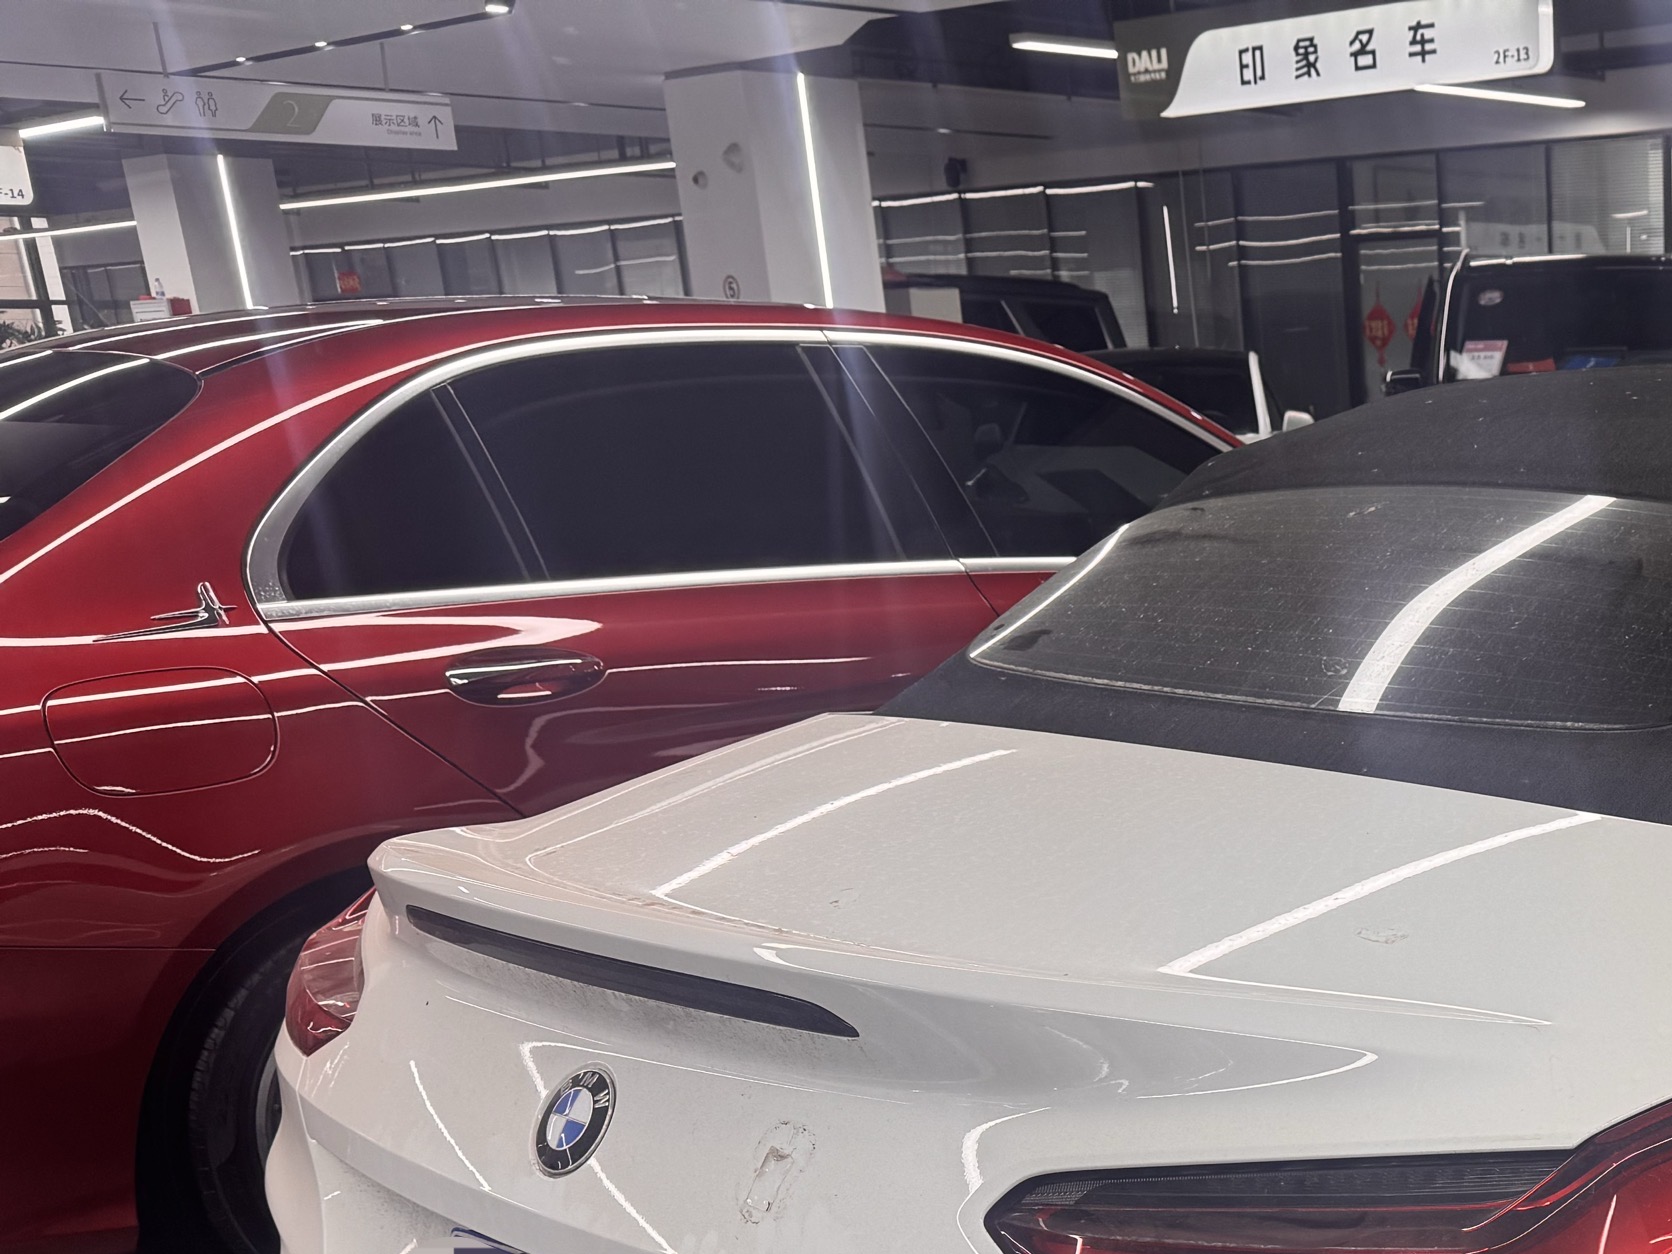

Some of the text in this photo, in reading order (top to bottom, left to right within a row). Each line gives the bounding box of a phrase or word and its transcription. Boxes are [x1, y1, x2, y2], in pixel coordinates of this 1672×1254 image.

[1126, 47, 1168, 73] DALI
[1238, 20, 1437, 86] 印象名车
[1494, 46, 1530, 64] 2F-13
[283, 100, 300, 128] 2
[371, 113, 420, 128] 展示区域
[560, 1071, 610, 1109] BMW
